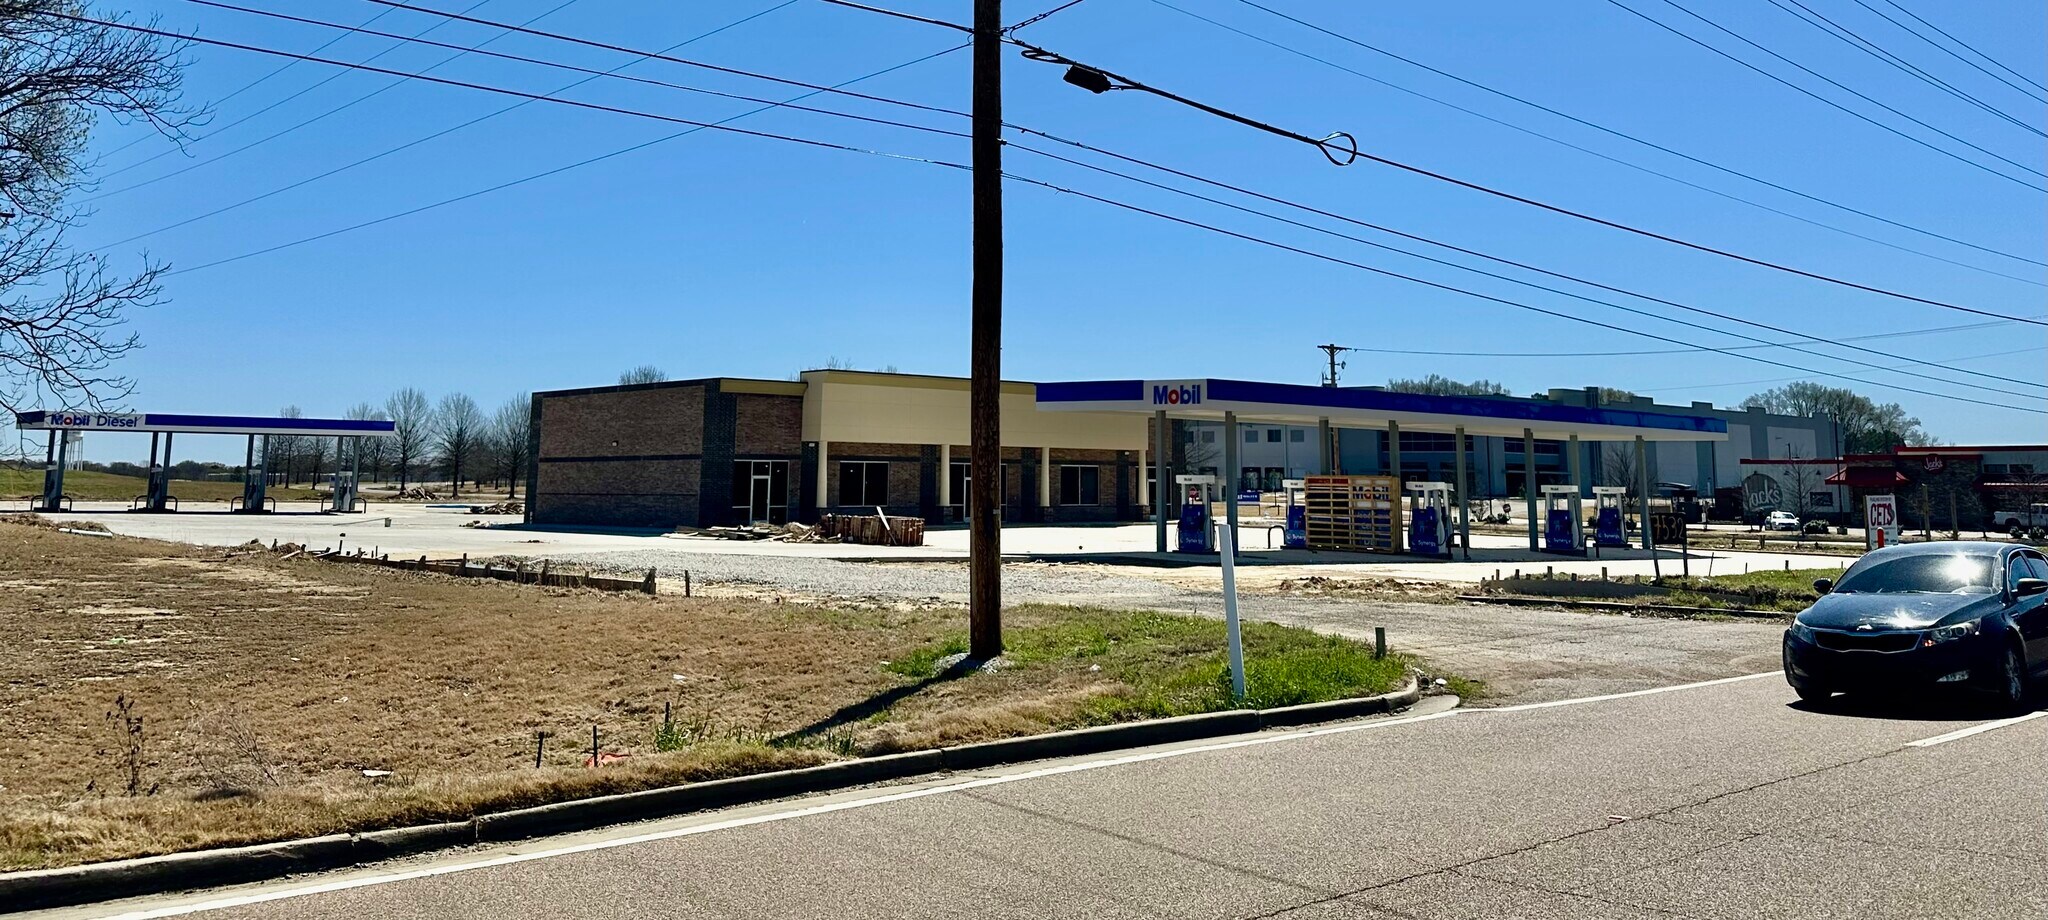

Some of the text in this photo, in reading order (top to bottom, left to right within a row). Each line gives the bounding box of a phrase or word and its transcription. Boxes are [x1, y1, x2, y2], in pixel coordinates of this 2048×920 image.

[1153, 384, 1201, 405] Mobil
[51, 413, 138, 427] Mobil Diesel
[1353, 486, 1389, 500] Mobil
